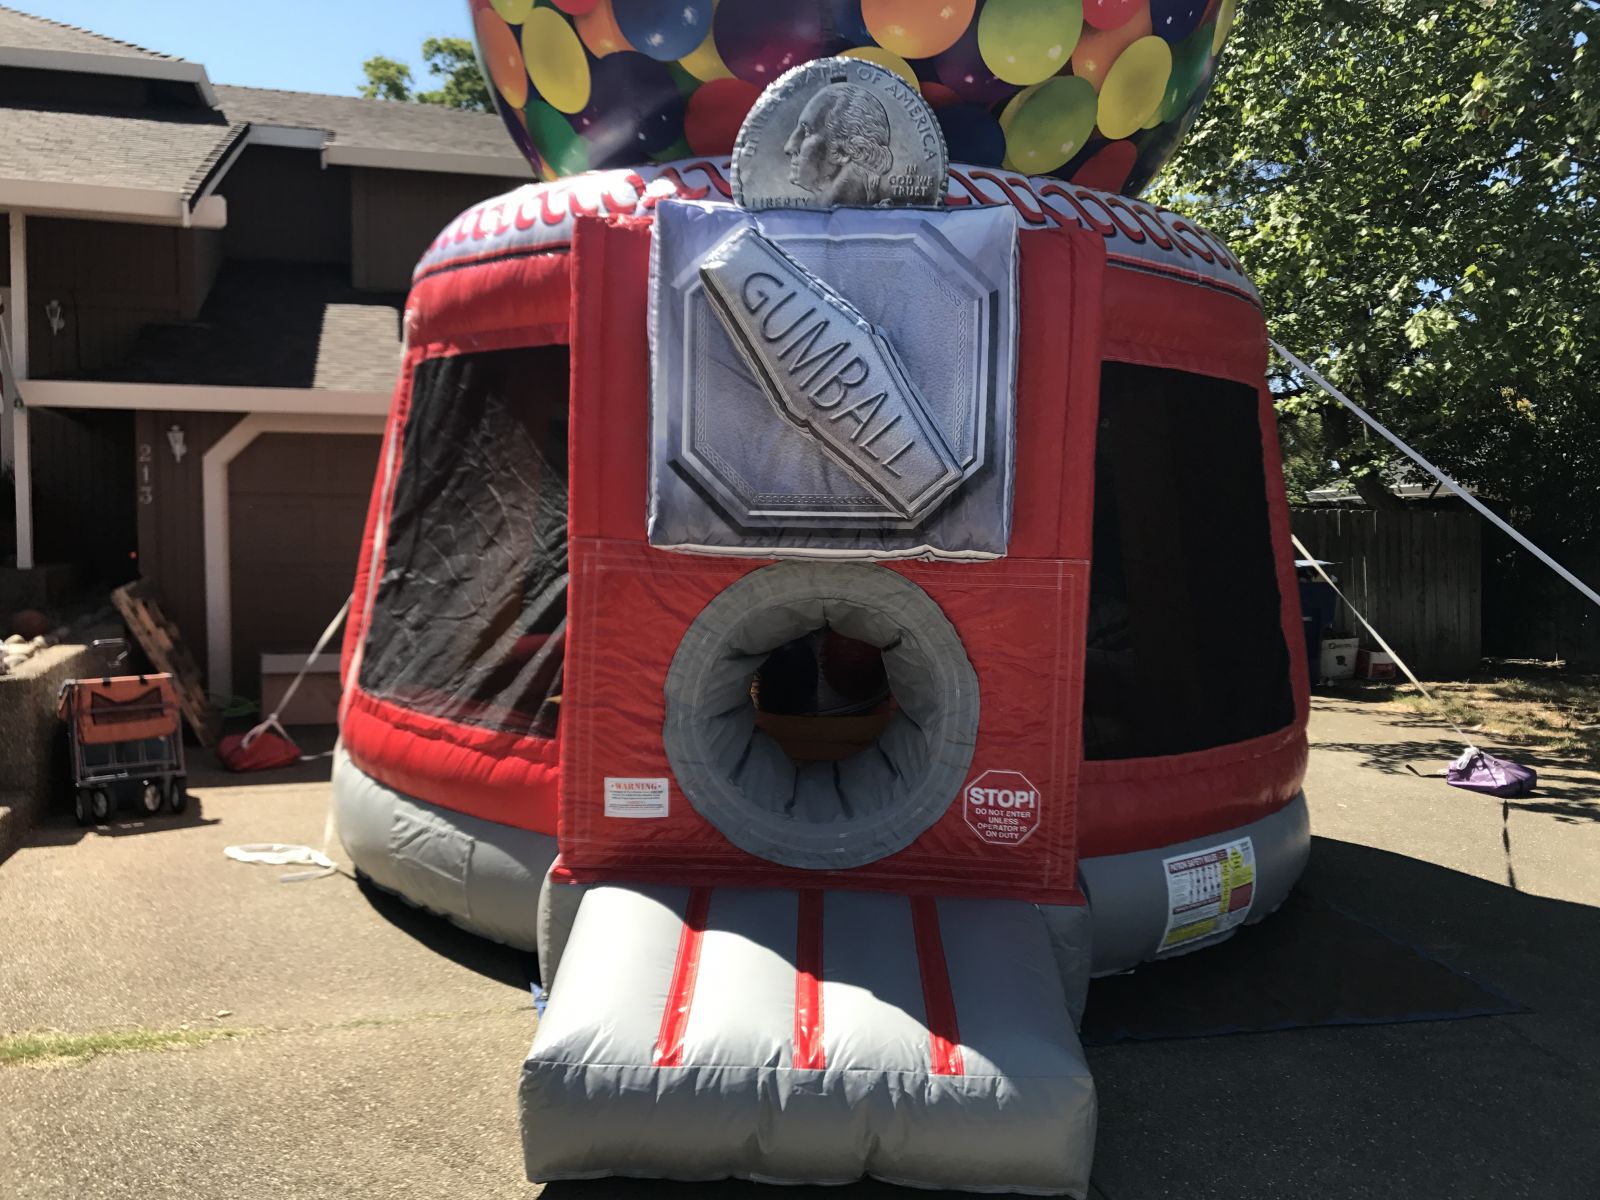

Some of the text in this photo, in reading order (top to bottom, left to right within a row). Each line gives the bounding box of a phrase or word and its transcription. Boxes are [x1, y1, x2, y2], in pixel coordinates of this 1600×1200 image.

[856, 67, 882, 85] OF
[885, 80, 938, 163] AMERICA
[904, 164, 918, 176] IN
[888, 174, 935, 188] GOD WE
[892, 185, 928, 198] TRUST
[751, 196, 810, 209] LIBERTY
[741, 272, 915, 477] GUMBALL
[970, 787, 1035, 808] STOP!
[1006, 810, 1031, 818] ENTER
[977, 823, 1018, 832] OPERATOR
[989, 817, 1019, 825] UNLESS
